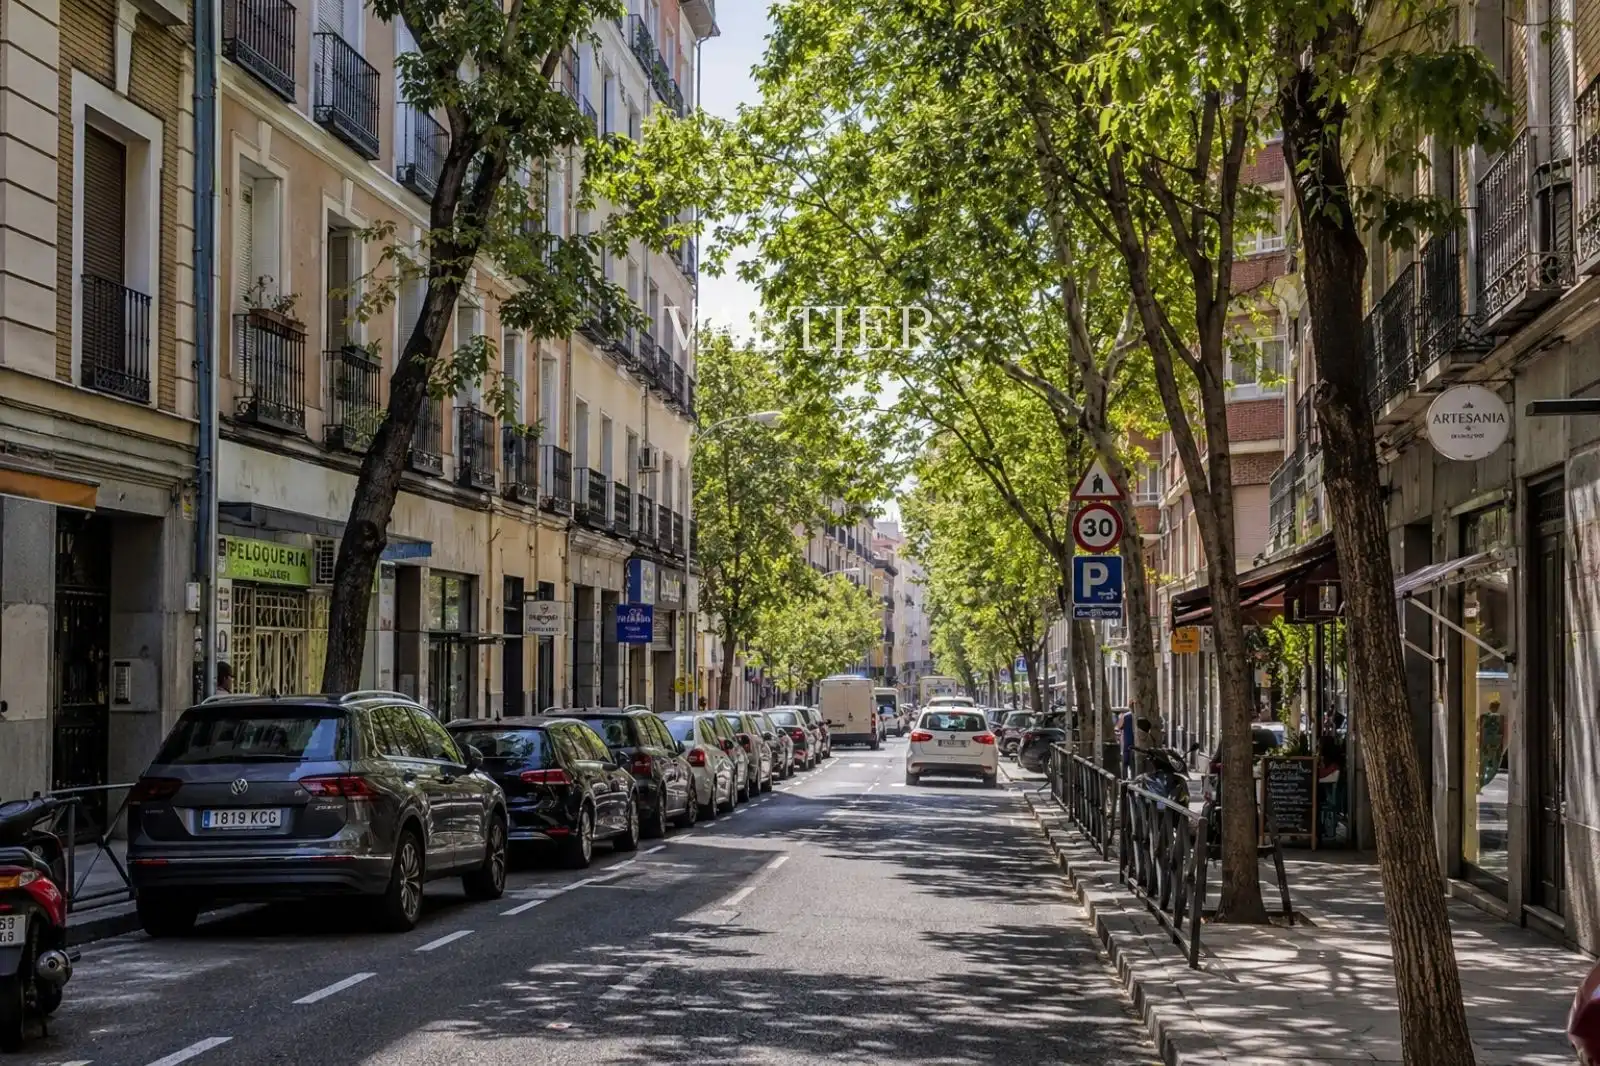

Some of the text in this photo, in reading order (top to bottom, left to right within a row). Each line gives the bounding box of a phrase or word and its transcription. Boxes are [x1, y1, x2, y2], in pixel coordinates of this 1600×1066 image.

[1433, 412, 1505, 424] ARTESANIA
[1083, 518, 1112, 537] 30
[1082, 562, 1109, 598] P
[213, 810, 277, 825] 1819 KCG
